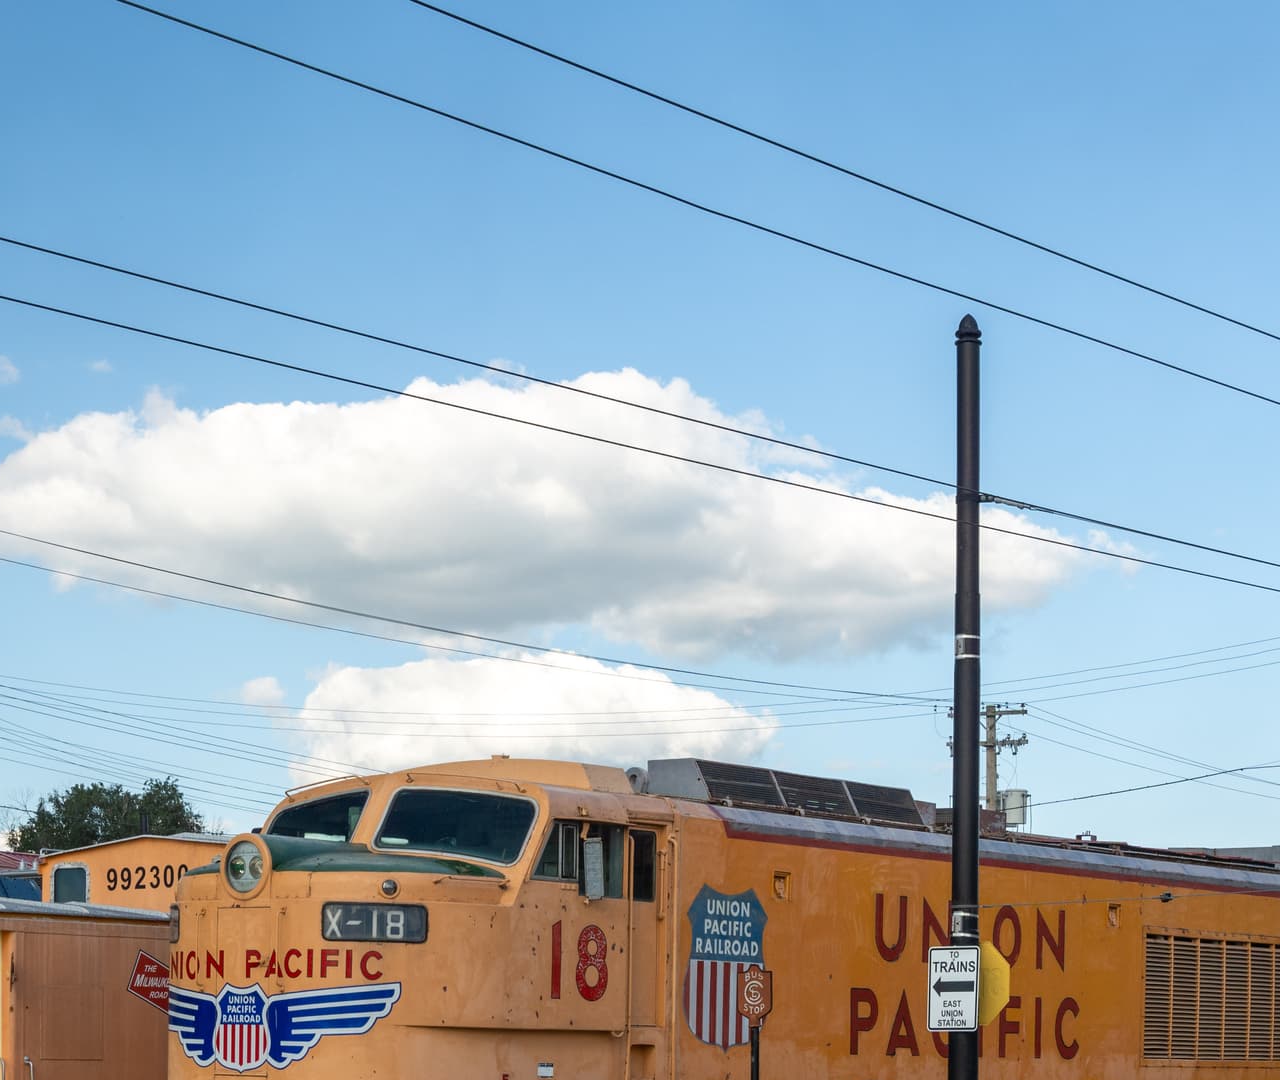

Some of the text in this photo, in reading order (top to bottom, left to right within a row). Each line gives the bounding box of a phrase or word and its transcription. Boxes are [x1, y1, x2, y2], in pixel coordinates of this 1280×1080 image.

[707, 899, 750, 917] UNION
[326, 908, 405, 939] X-18
[704, 918, 752, 937] PACIFIC
[874, 893, 1067, 973] UNON
[696, 937, 758, 956] RAILROAD
[550, 919, 609, 1001] 18
[949, 951, 960, 959] TO
[144, 964, 158, 973] THE
[170, 948, 384, 980] NION PACIFIC
[933, 961, 976, 973] TRAINS
[744, 971, 764, 983] BUS
[149, 991, 168, 999] ROAD
[228, 995, 256, 1004] UNION
[227, 1005, 257, 1013] PACIFIC
[743, 1003, 765, 1014] STOP
[943, 1000, 962, 1008] EAST
[222, 1014, 261, 1023] RAILROAD
[941, 1009, 963, 1018] UNION
[850, 987, 1080, 1060] PAFIC
[937, 1019, 967, 1027] STATION
